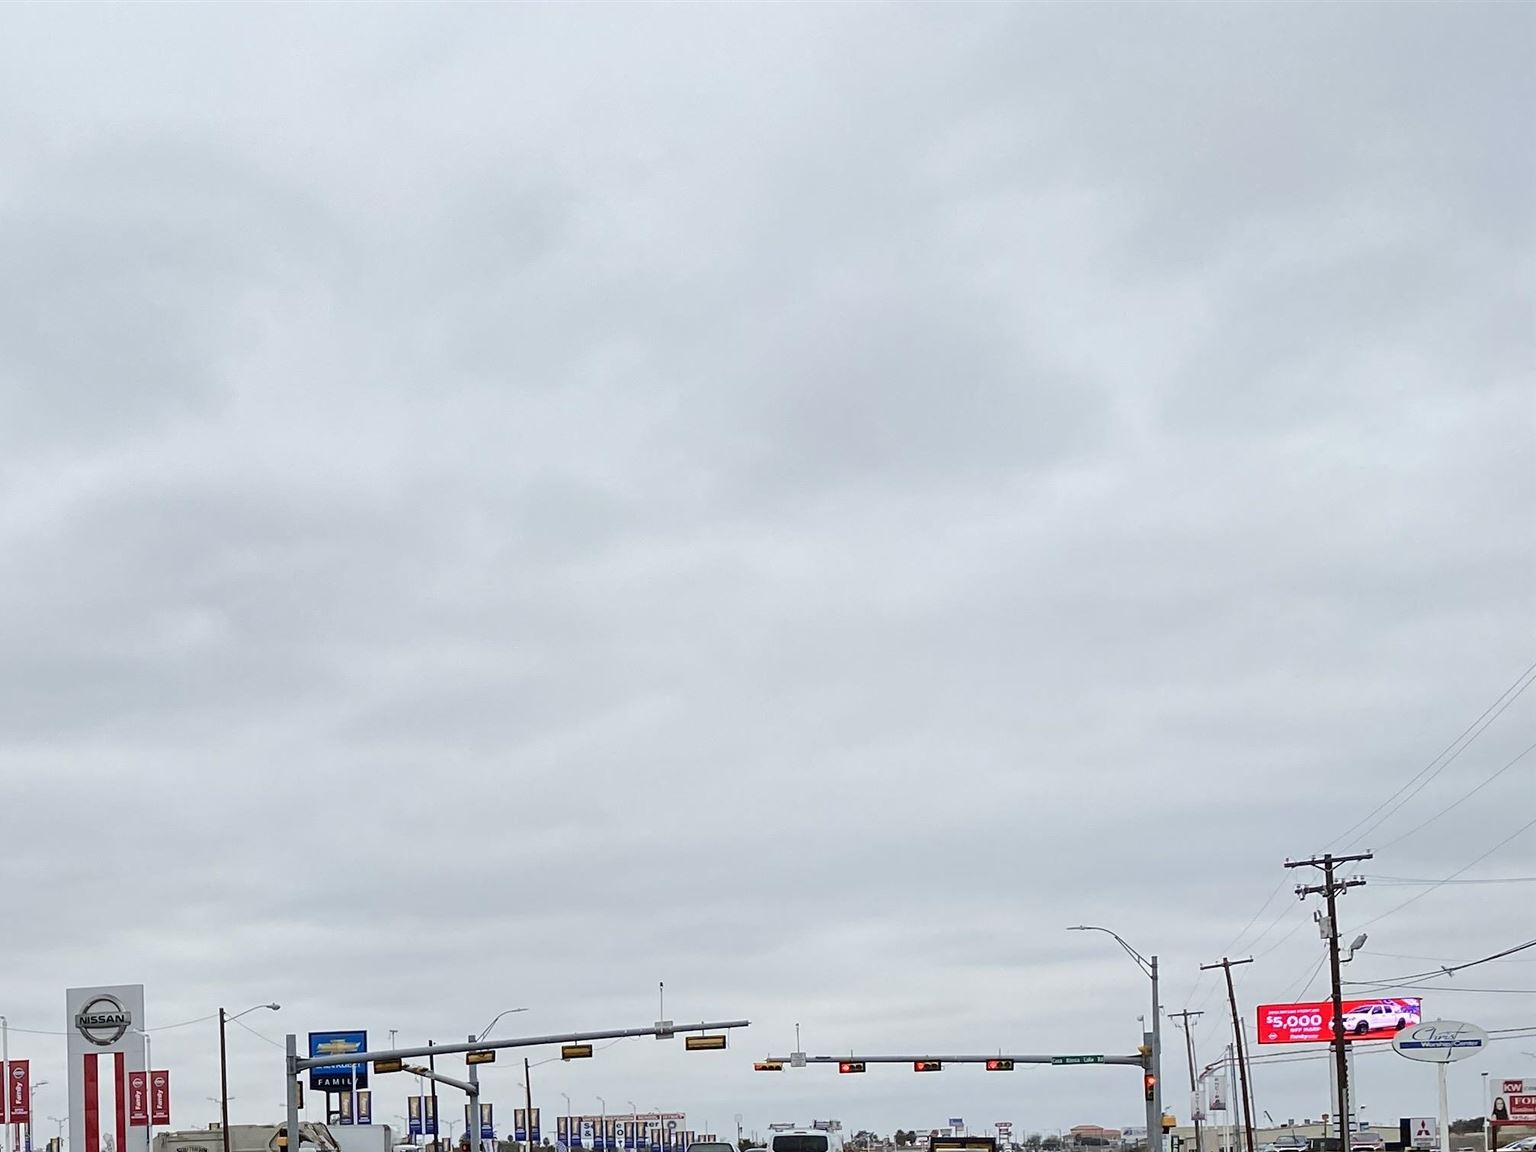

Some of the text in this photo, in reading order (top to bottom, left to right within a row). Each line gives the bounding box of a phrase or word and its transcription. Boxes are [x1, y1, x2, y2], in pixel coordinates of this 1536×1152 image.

[80, 1015, 124, 1025] NISSAN
[1266, 1014, 1322, 1029] $5,000
[15, 1081, 23, 1105] Family
[1504, 1083, 1522, 1092] KW
